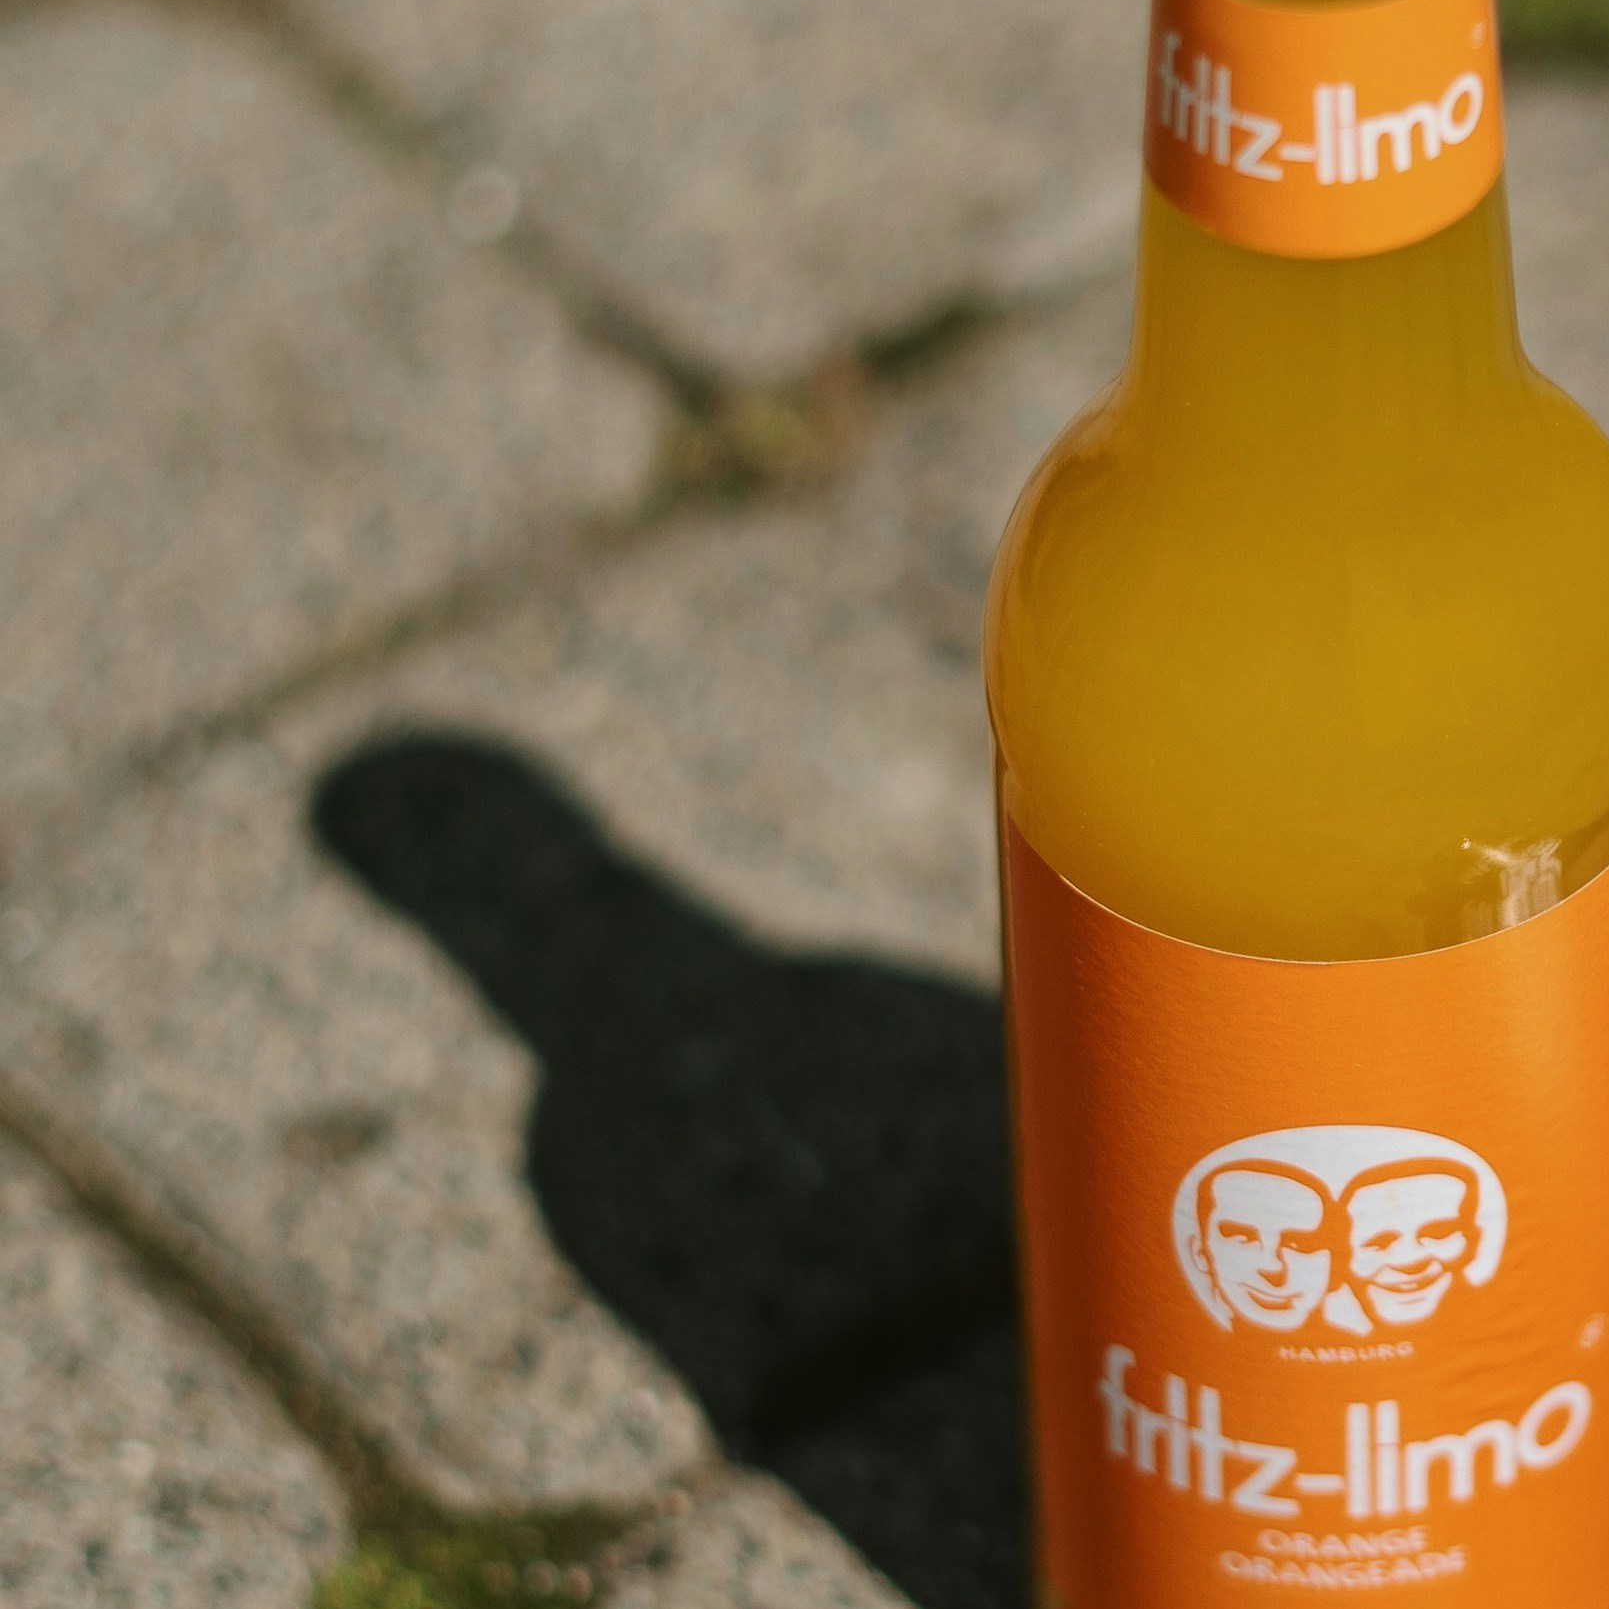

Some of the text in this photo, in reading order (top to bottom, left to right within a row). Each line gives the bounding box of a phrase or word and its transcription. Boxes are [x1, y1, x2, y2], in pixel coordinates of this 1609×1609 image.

[1158, 31, 1485, 185] fritz-limo
[1100, 1345, 1593, 1519] fritz-limo
[1257, 1525, 1427, 1559] ORANGE
